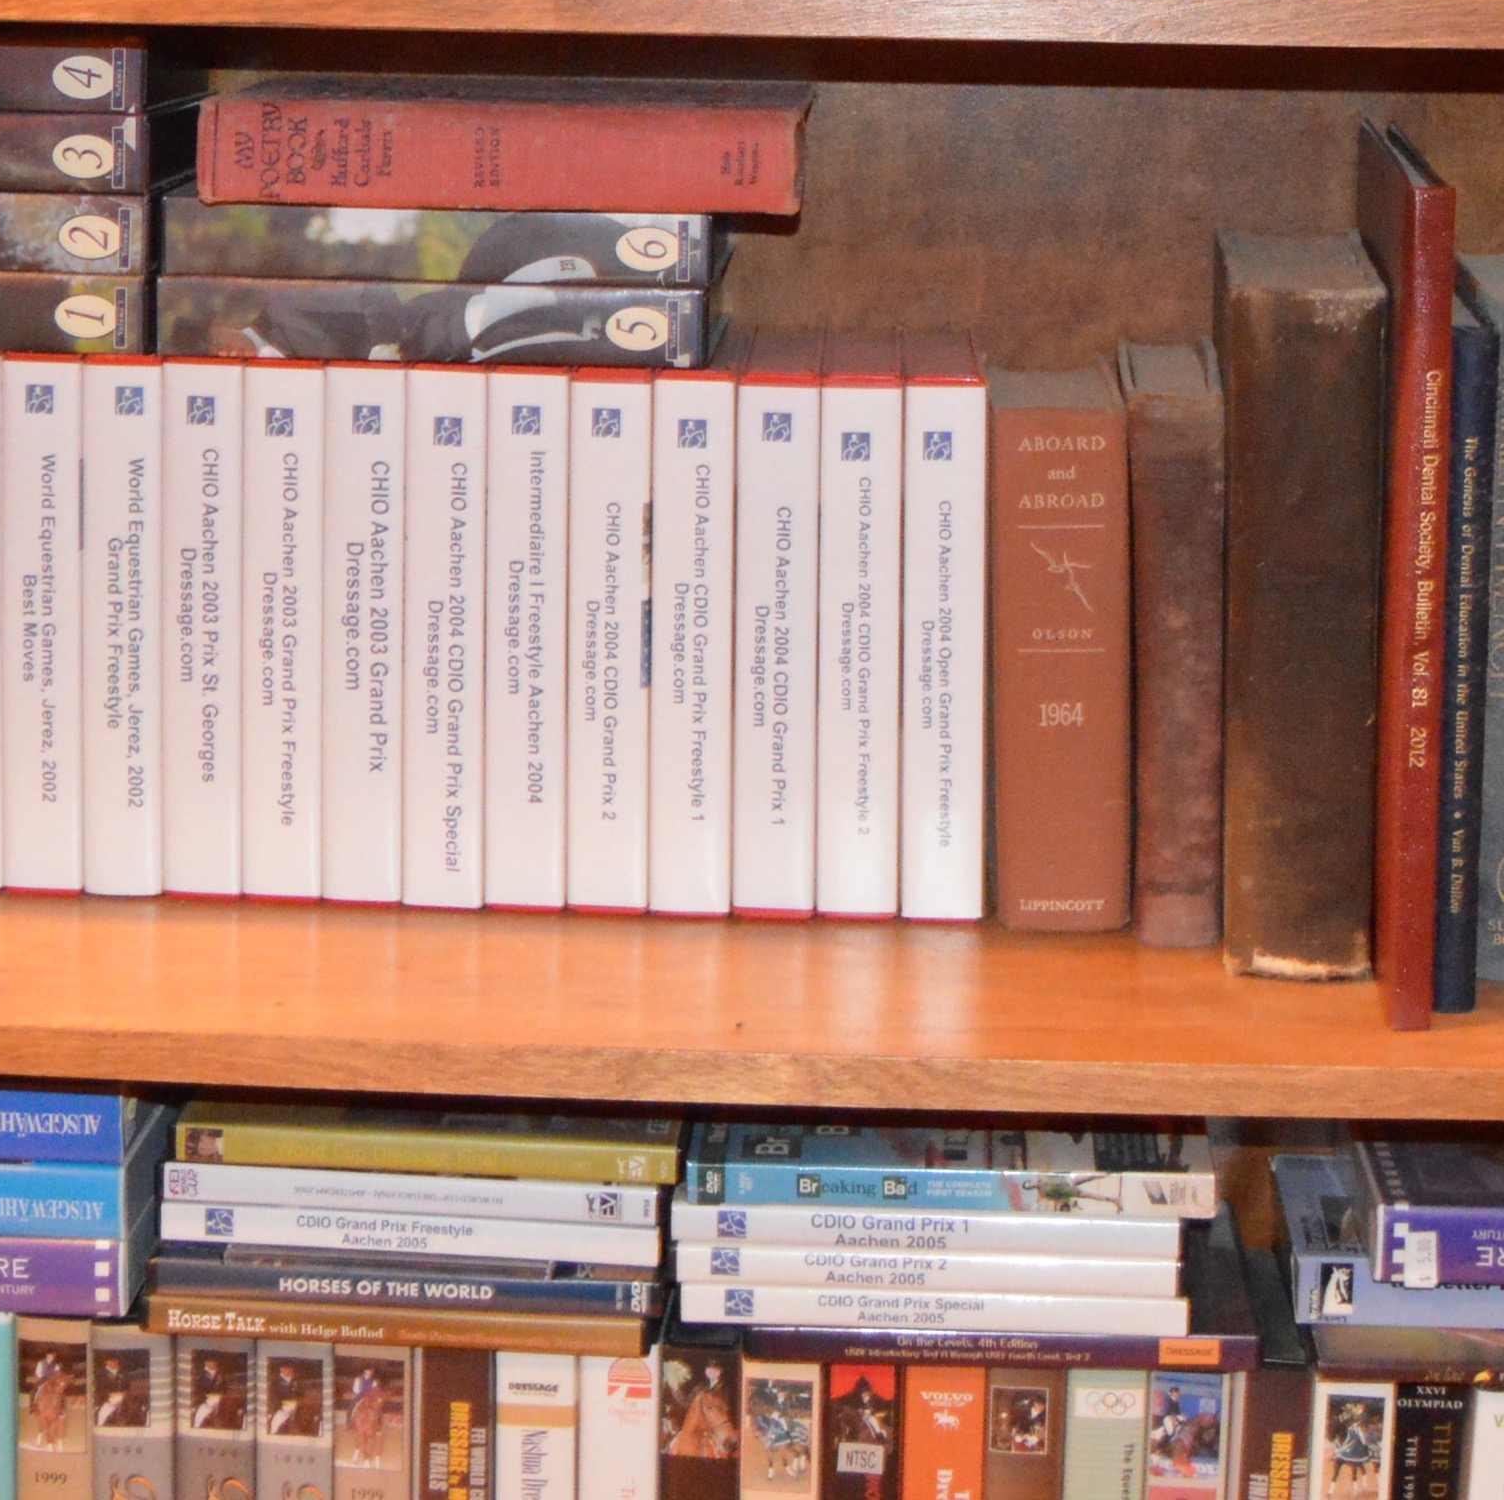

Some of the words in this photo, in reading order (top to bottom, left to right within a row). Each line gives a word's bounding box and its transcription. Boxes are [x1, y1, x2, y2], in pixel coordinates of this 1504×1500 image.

[62, 64, 102, 89] 4
[61, 146, 103, 170] 3
[285, 115, 308, 187] BOOK
[68, 226, 109, 251] 2
[626, 237, 667, 259] 6
[64, 308, 105, 327] 1
[616, 318, 657, 341] 5
[1419, 367, 1445, 450] Cincinnati
[1017, 434, 1107, 452] ABOARD
[40, 452, 57, 510] World
[370, 459, 391, 515] CHIO
[1046, 464, 1077, 480] and
[1416, 453, 1441, 506] Dental
[1017, 491, 1106, 509] ABROAD
[1413, 510, 1437, 576] Society,
[36, 514, 56, 617] Equestrian
[369, 520, 390, 600] Aachen
[341, 540, 366, 691] Dressage.com
[368, 605, 389, 655] 2003
[1030, 627, 1095, 640] OLSON
[39, 621, 57, 692] Games,
[1410, 648, 1432, 682] Vol.
[368, 661, 389, 725] Grand
[1409, 686, 1430, 709] 81
[39, 697, 57, 753] Jerez,
[1037, 701, 1085, 727] 1964
[368, 731, 388, 773] Prix
[1408, 725, 1429, 768] 2012
[40, 759, 57, 803] 2002
[1018, 897, 1107, 912] LIPPINCOTT
[794, 1172, 877, 1199] Breaking
[880, 1174, 918, 1201] Bad
[295, 1213, 332, 1229] CDIO
[334, 1215, 377, 1232] Grand
[379, 1218, 407, 1233] Prix
[410, 1220, 475, 1239] Freestyle
[340, 1231, 392, 1247] Aachen
[395, 1235, 428, 1249] 2005
[278, 1276, 352, 1296] HORSES
[355, 1278, 382, 1296] OF
[385, 1280, 420, 1298] THE
[423, 1282, 494, 1300] WORLD
[166, 1307, 222, 1331] HORSE
[224, 1310, 267, 1333] TALK
[267, 1321, 298, 1335] with
[300, 1322, 338, 1338] Helge
[1396, 1397, 1463, 1410] OLYMPIAD
